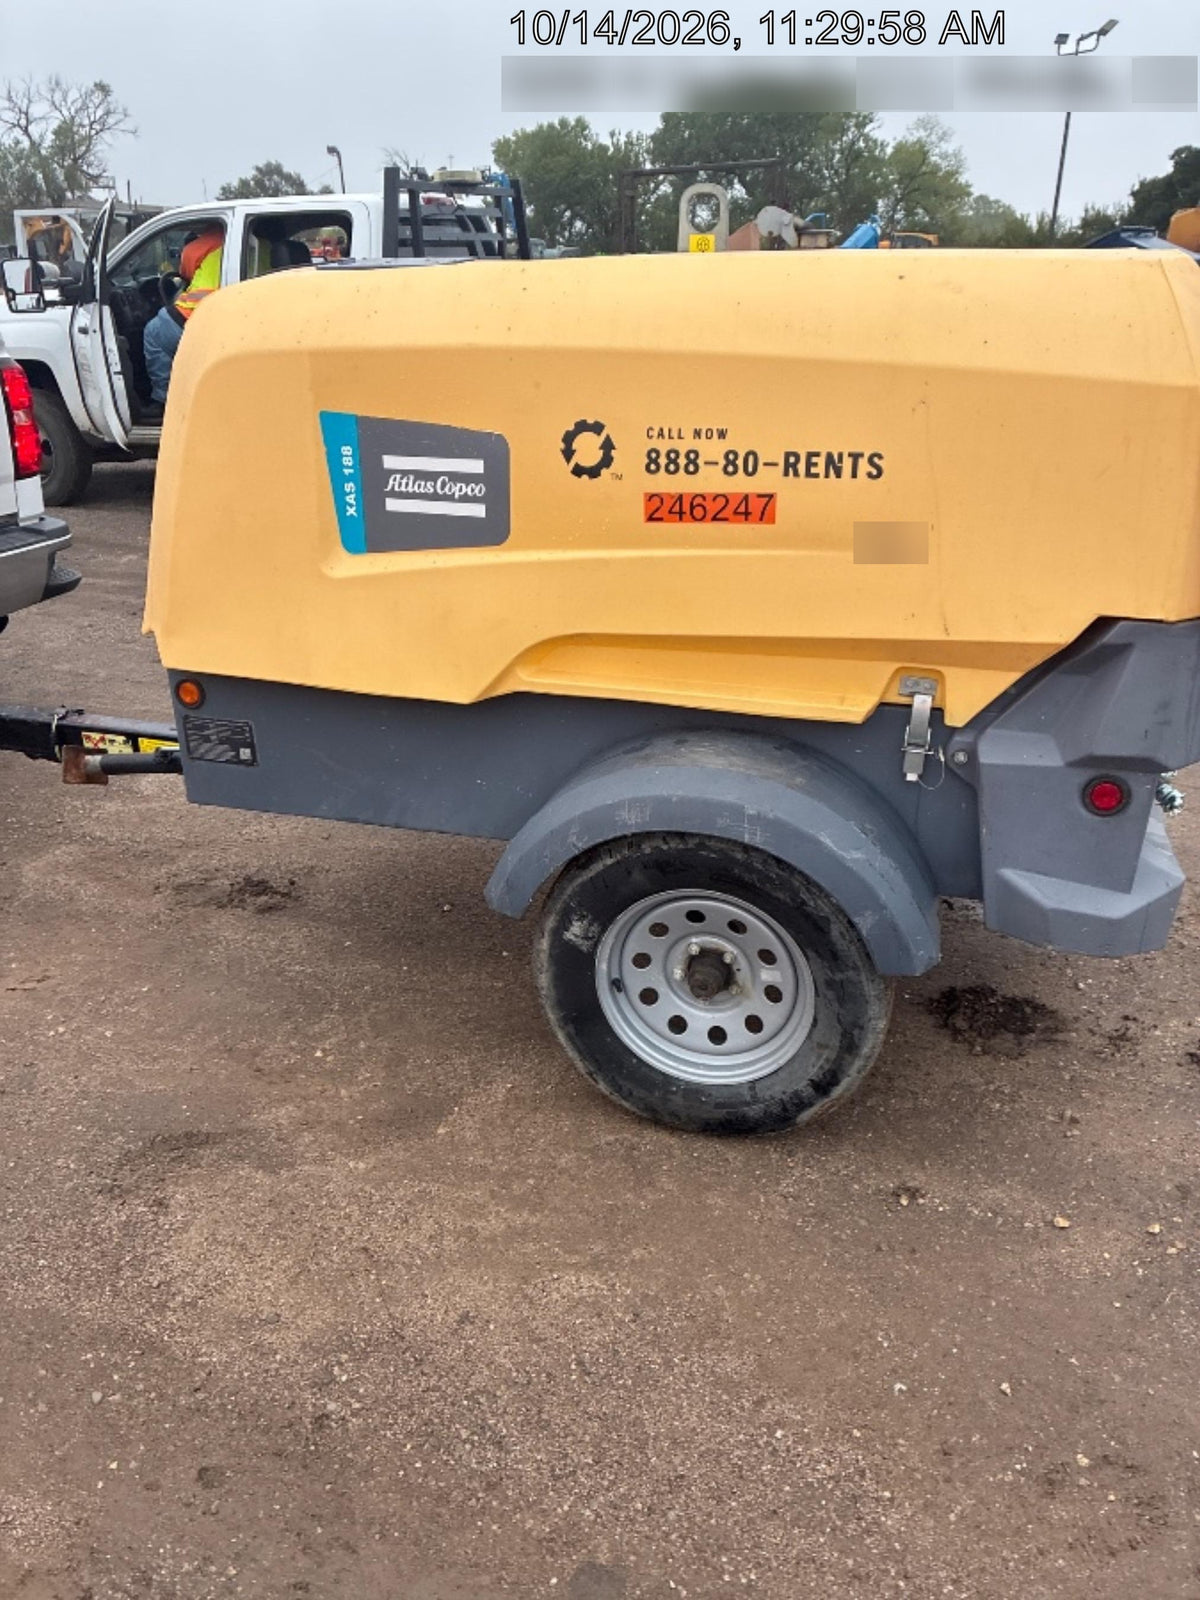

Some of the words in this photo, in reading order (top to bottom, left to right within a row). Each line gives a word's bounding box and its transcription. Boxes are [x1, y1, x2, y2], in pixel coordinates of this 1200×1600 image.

[646, 426, 685, 440] CALL
[692, 427, 729, 440] NOW
[341, 445, 355, 475] 188
[644, 447, 886, 481] 888-80-RENTS
[610, 472, 624, 481] TM
[345, 481, 358, 518] XAS
[645, 493, 775, 523] 246247
